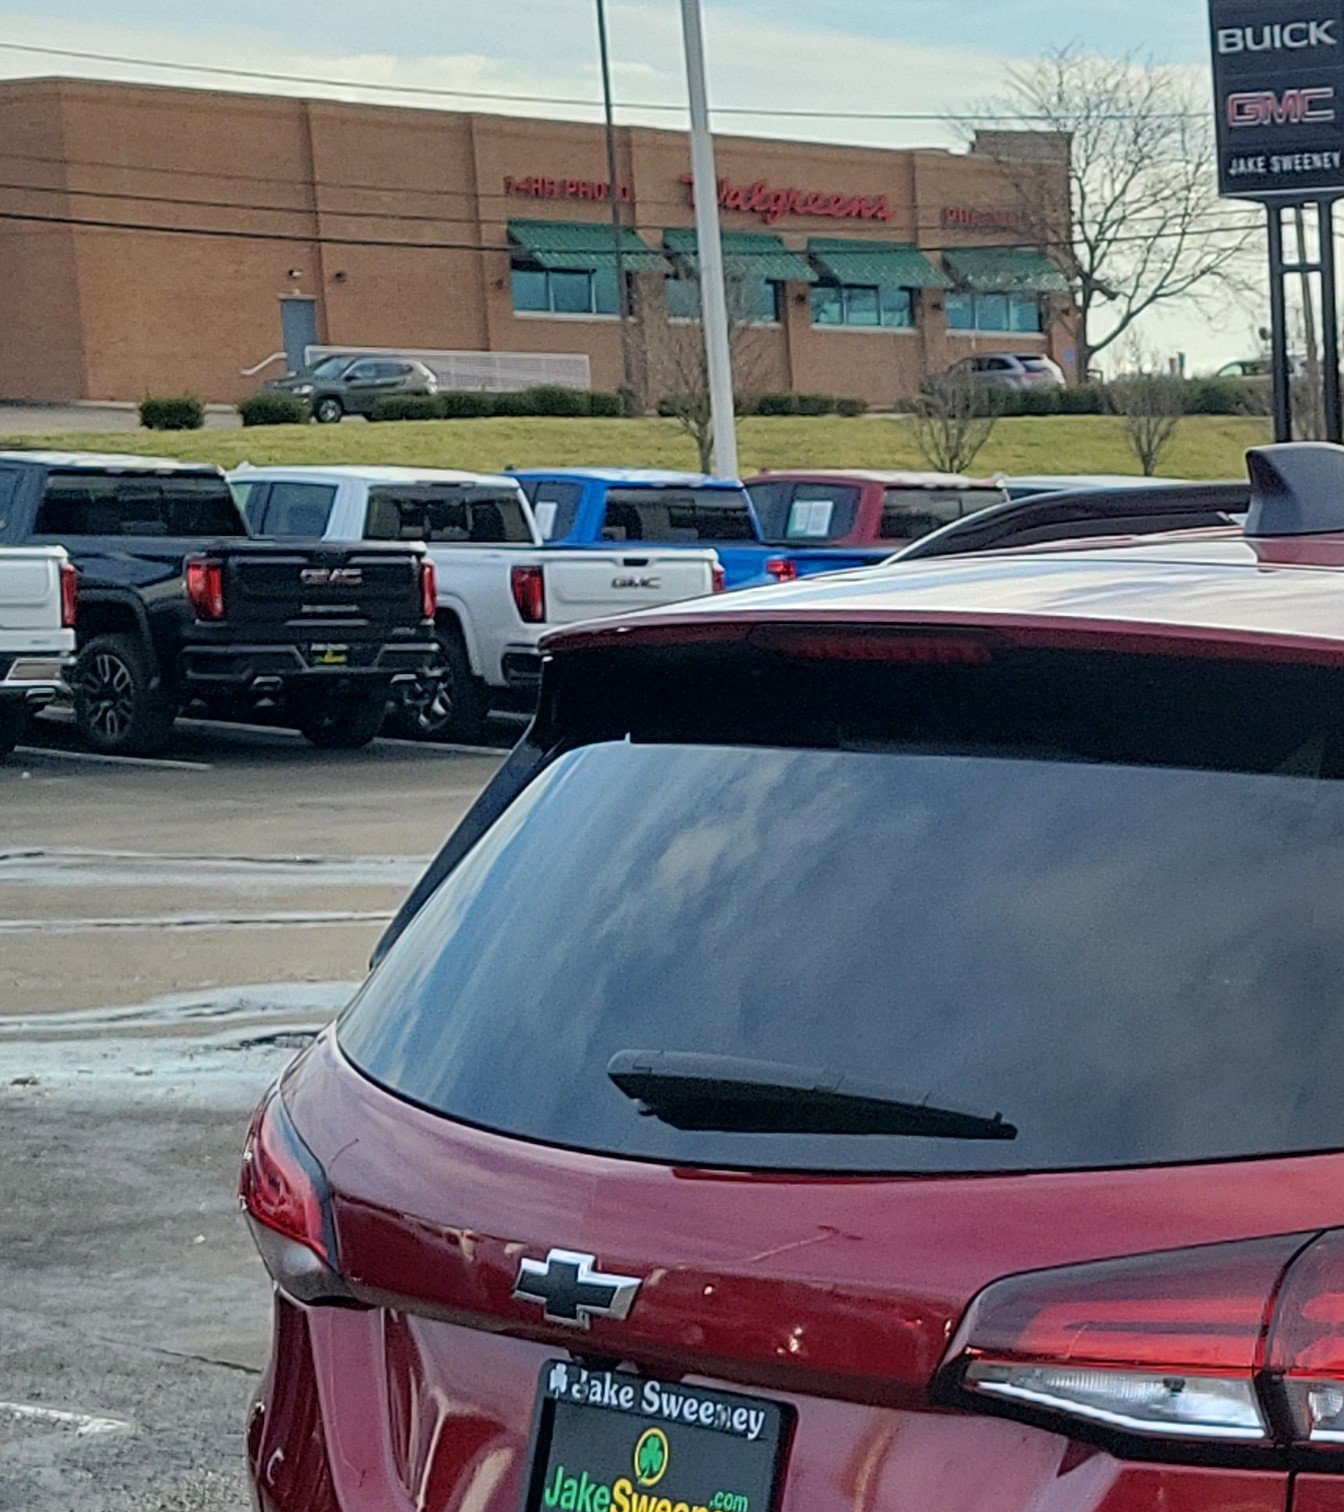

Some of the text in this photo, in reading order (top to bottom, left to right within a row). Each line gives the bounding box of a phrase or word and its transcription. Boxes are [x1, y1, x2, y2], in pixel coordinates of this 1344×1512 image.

[1217, 20, 1338, 54] BUICK
[1227, 87, 1335, 127] GMC
[1228, 151, 1342, 176] JAKE SWEENEY
[566, 181, 631, 201] PHOO
[571, 1368, 635, 1409] Jake
